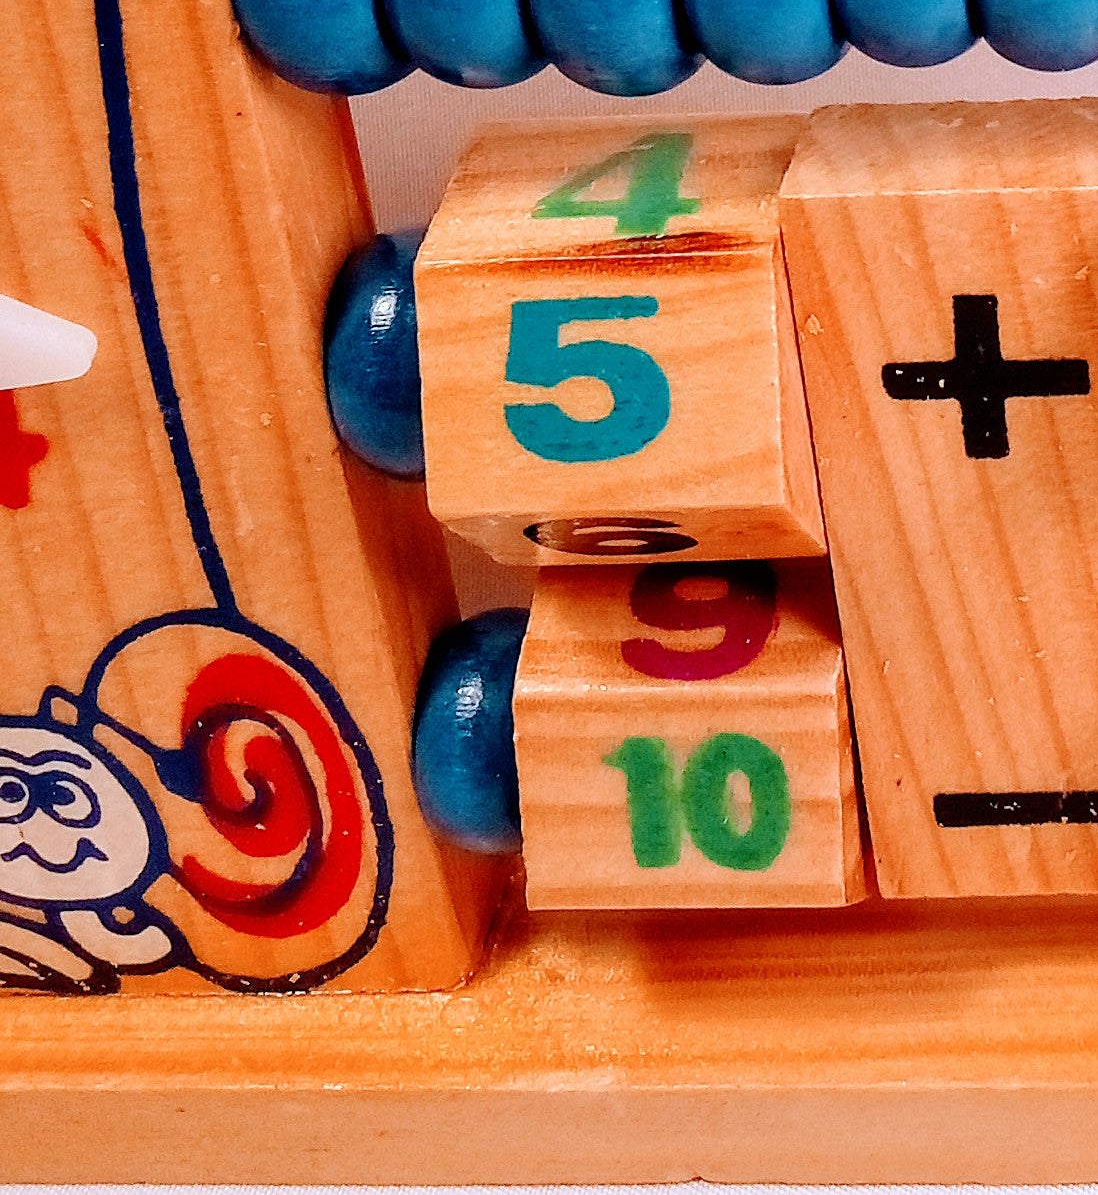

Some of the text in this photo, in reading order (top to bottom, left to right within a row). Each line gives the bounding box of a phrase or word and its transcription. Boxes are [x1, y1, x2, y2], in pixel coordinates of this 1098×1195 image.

[531, 132, 700, 237] 4
[503, 295, 671, 463] 5
[522, 517, 700, 556] 6
[621, 560, 780, 681] 9
[602, 732, 791, 871] 10
